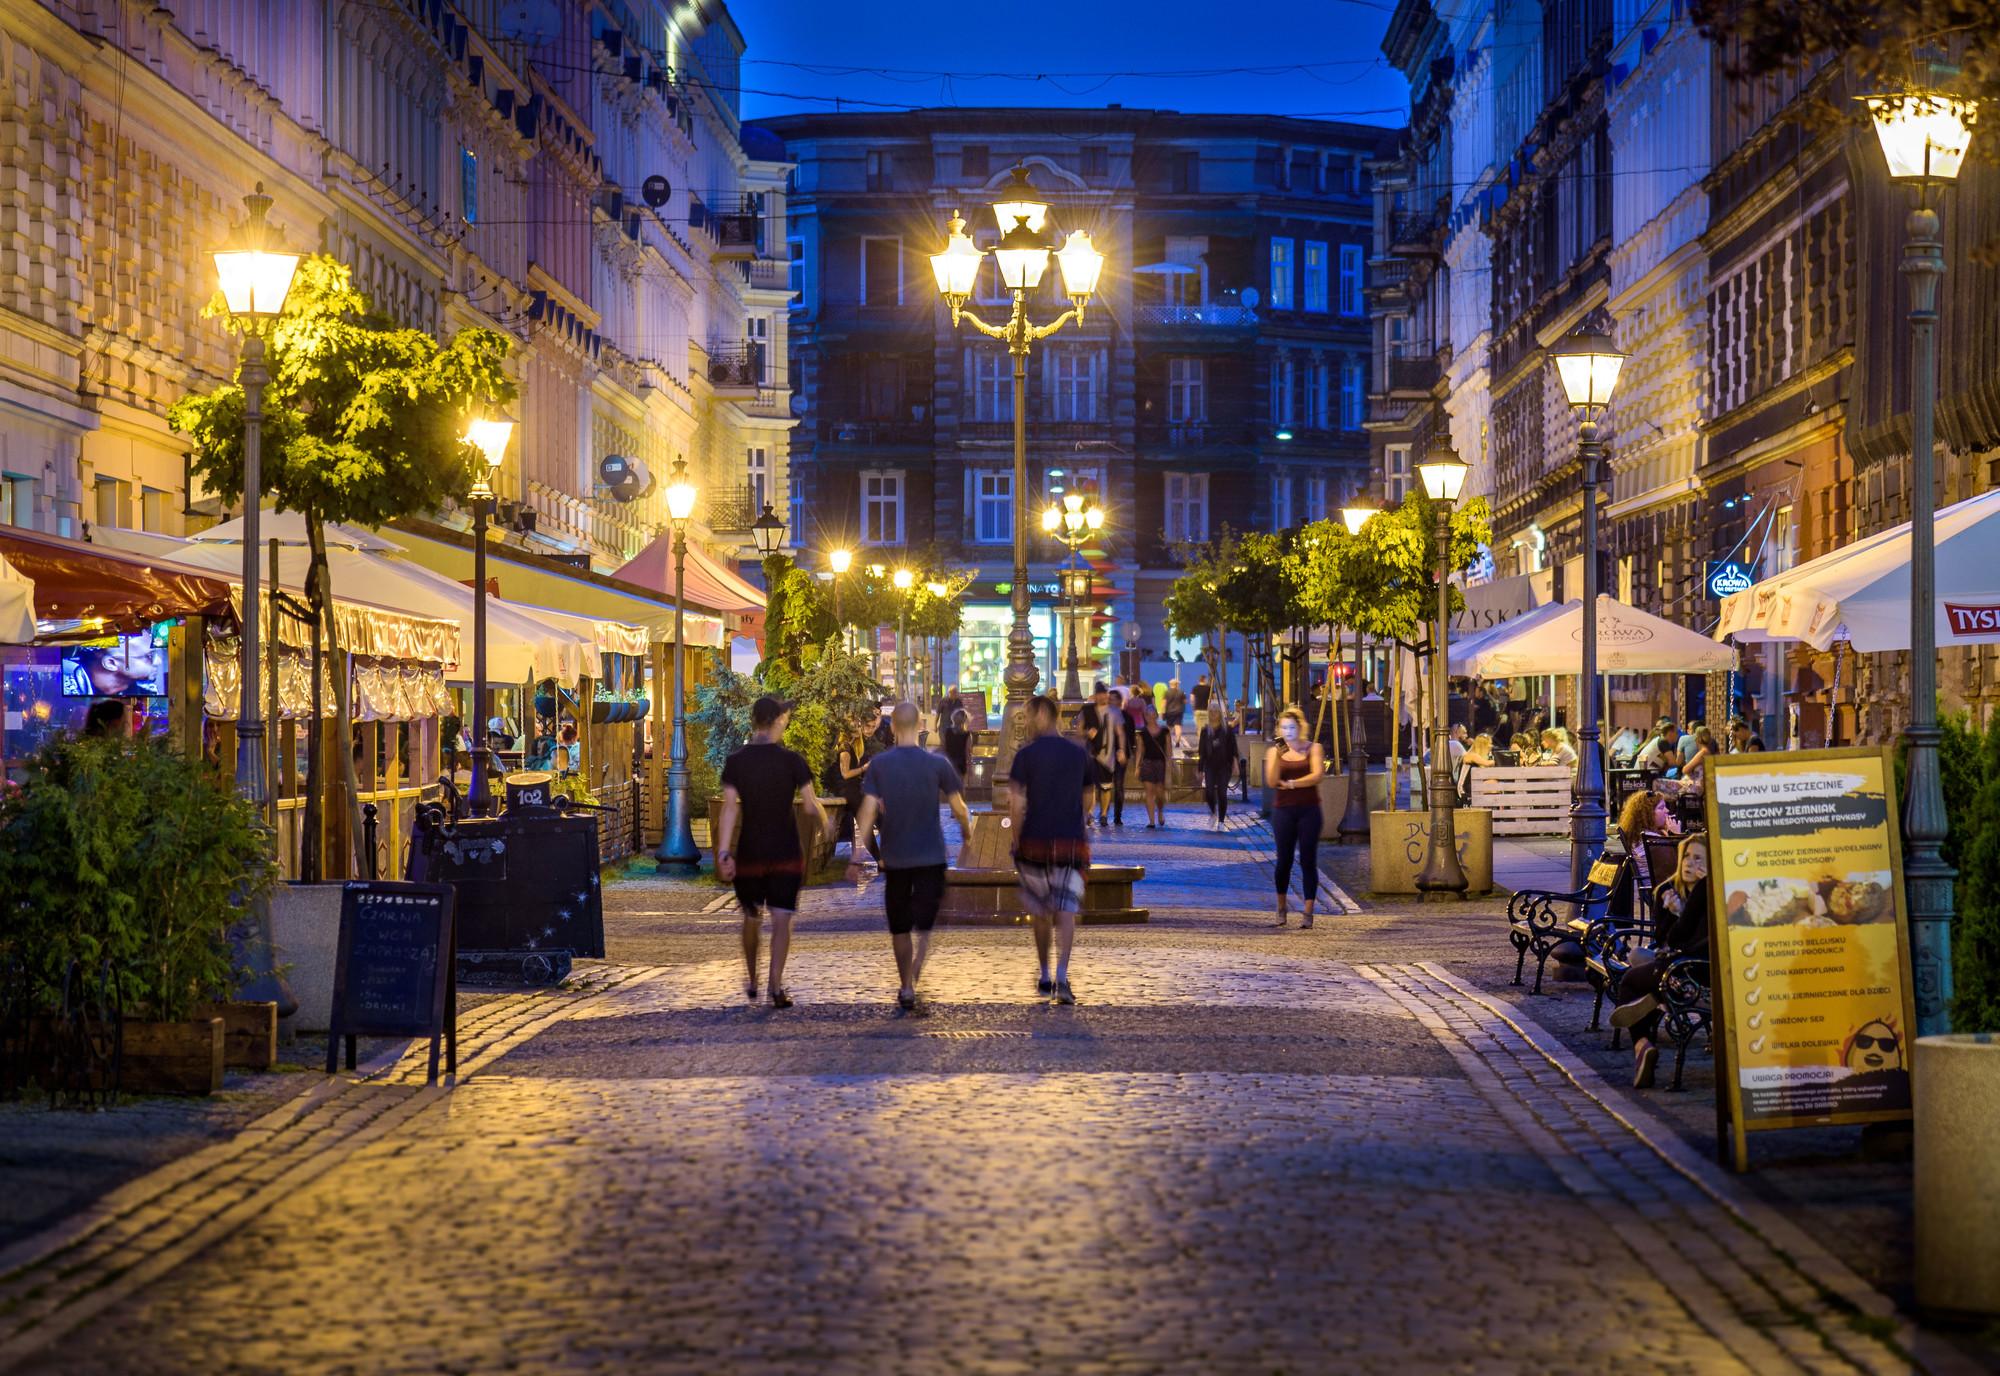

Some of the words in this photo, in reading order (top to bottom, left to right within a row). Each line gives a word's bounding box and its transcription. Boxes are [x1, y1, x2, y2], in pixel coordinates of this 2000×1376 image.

[1717, 579, 1747, 587] KROWA
[1728, 784, 1768, 796] JEDYNY
[1771, 783, 1780, 793] W
[1783, 779, 1844, 792] SZCZECINIE
[517, 789, 543, 805] 102
[1729, 806, 1783, 819] PIECZONY
[1785, 803, 1837, 816] ZIEMNIAK
[1730, 819, 1752, 829] ORAZ
[1753, 818, 1771, 827] INNE
[1772, 815, 1830, 827] NIESPOTYKANE
[1831, 812, 1867, 822] FRYKASY
[1756, 848, 1794, 857] PIECZONY
[1796, 846, 1832, 855] ZIEMNIAK
[1798, 856, 1836, 864] SPOSOBY
[1788, 966, 1845, 975] KARTOFLANKA
[1752, 1073, 1783, 1082] UWAGA
[1785, 1071, 1834, 1080] PROMOCJA!
